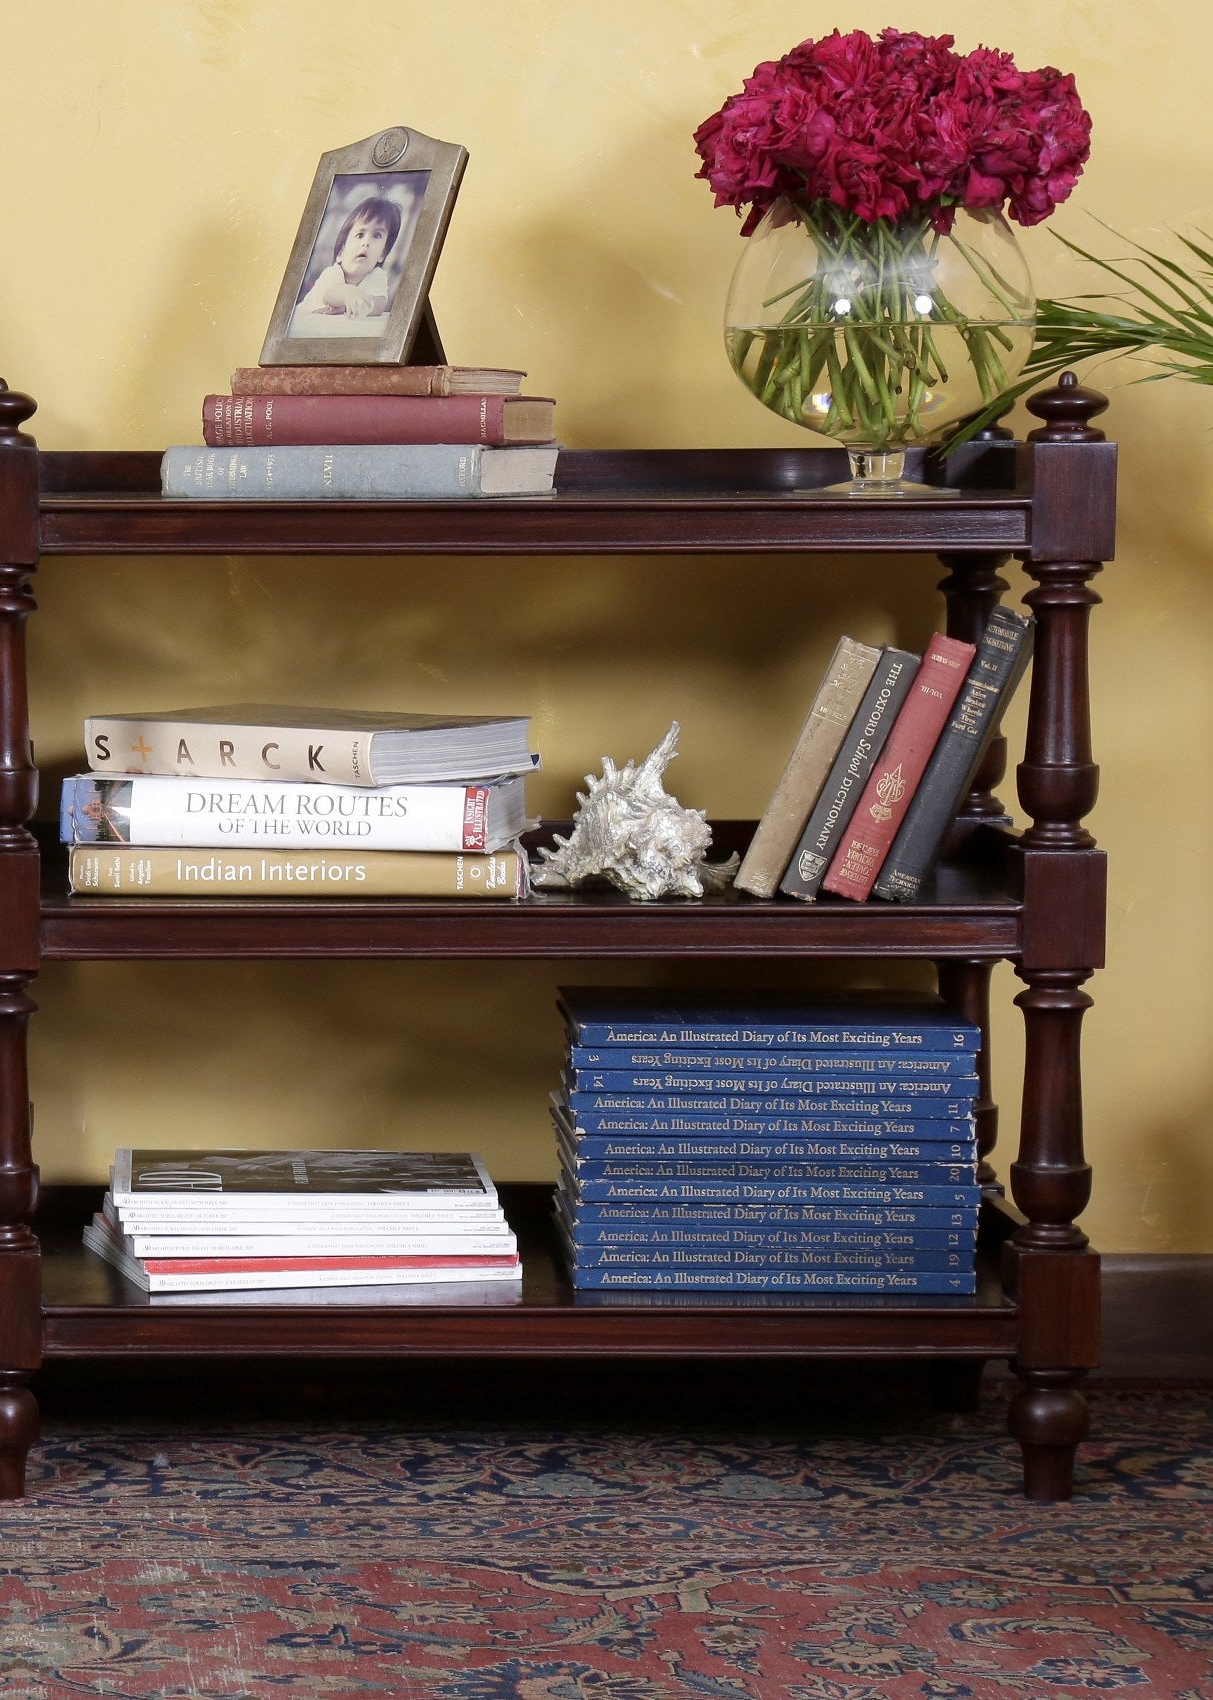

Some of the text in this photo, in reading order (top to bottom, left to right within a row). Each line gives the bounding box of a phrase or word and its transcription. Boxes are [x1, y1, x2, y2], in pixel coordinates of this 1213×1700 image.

[239, 464, 247, 478] LAW
[324, 455, 334, 488] XLVII
[458, 456, 467, 487] OXFORD
[980, 660, 991, 670] Vol.
[815, 662, 903, 850] THE OXFORD School DICTIONARY
[186, 792, 408, 818] DREAM ROUTES
[465, 797, 476, 824] INSIGHT
[473, 790, 485, 833] ILLUSTRATED
[218, 818, 371, 837] OF THE WORLD
[177, 858, 366, 881] Indian Interiors
[593, 1075, 952, 1094] America: An Illustrated Diary of Its Most Exciting Years 14
[600, 1273, 961, 1289] America: An Illustrated Diary of Its Most Exciting Years 4
